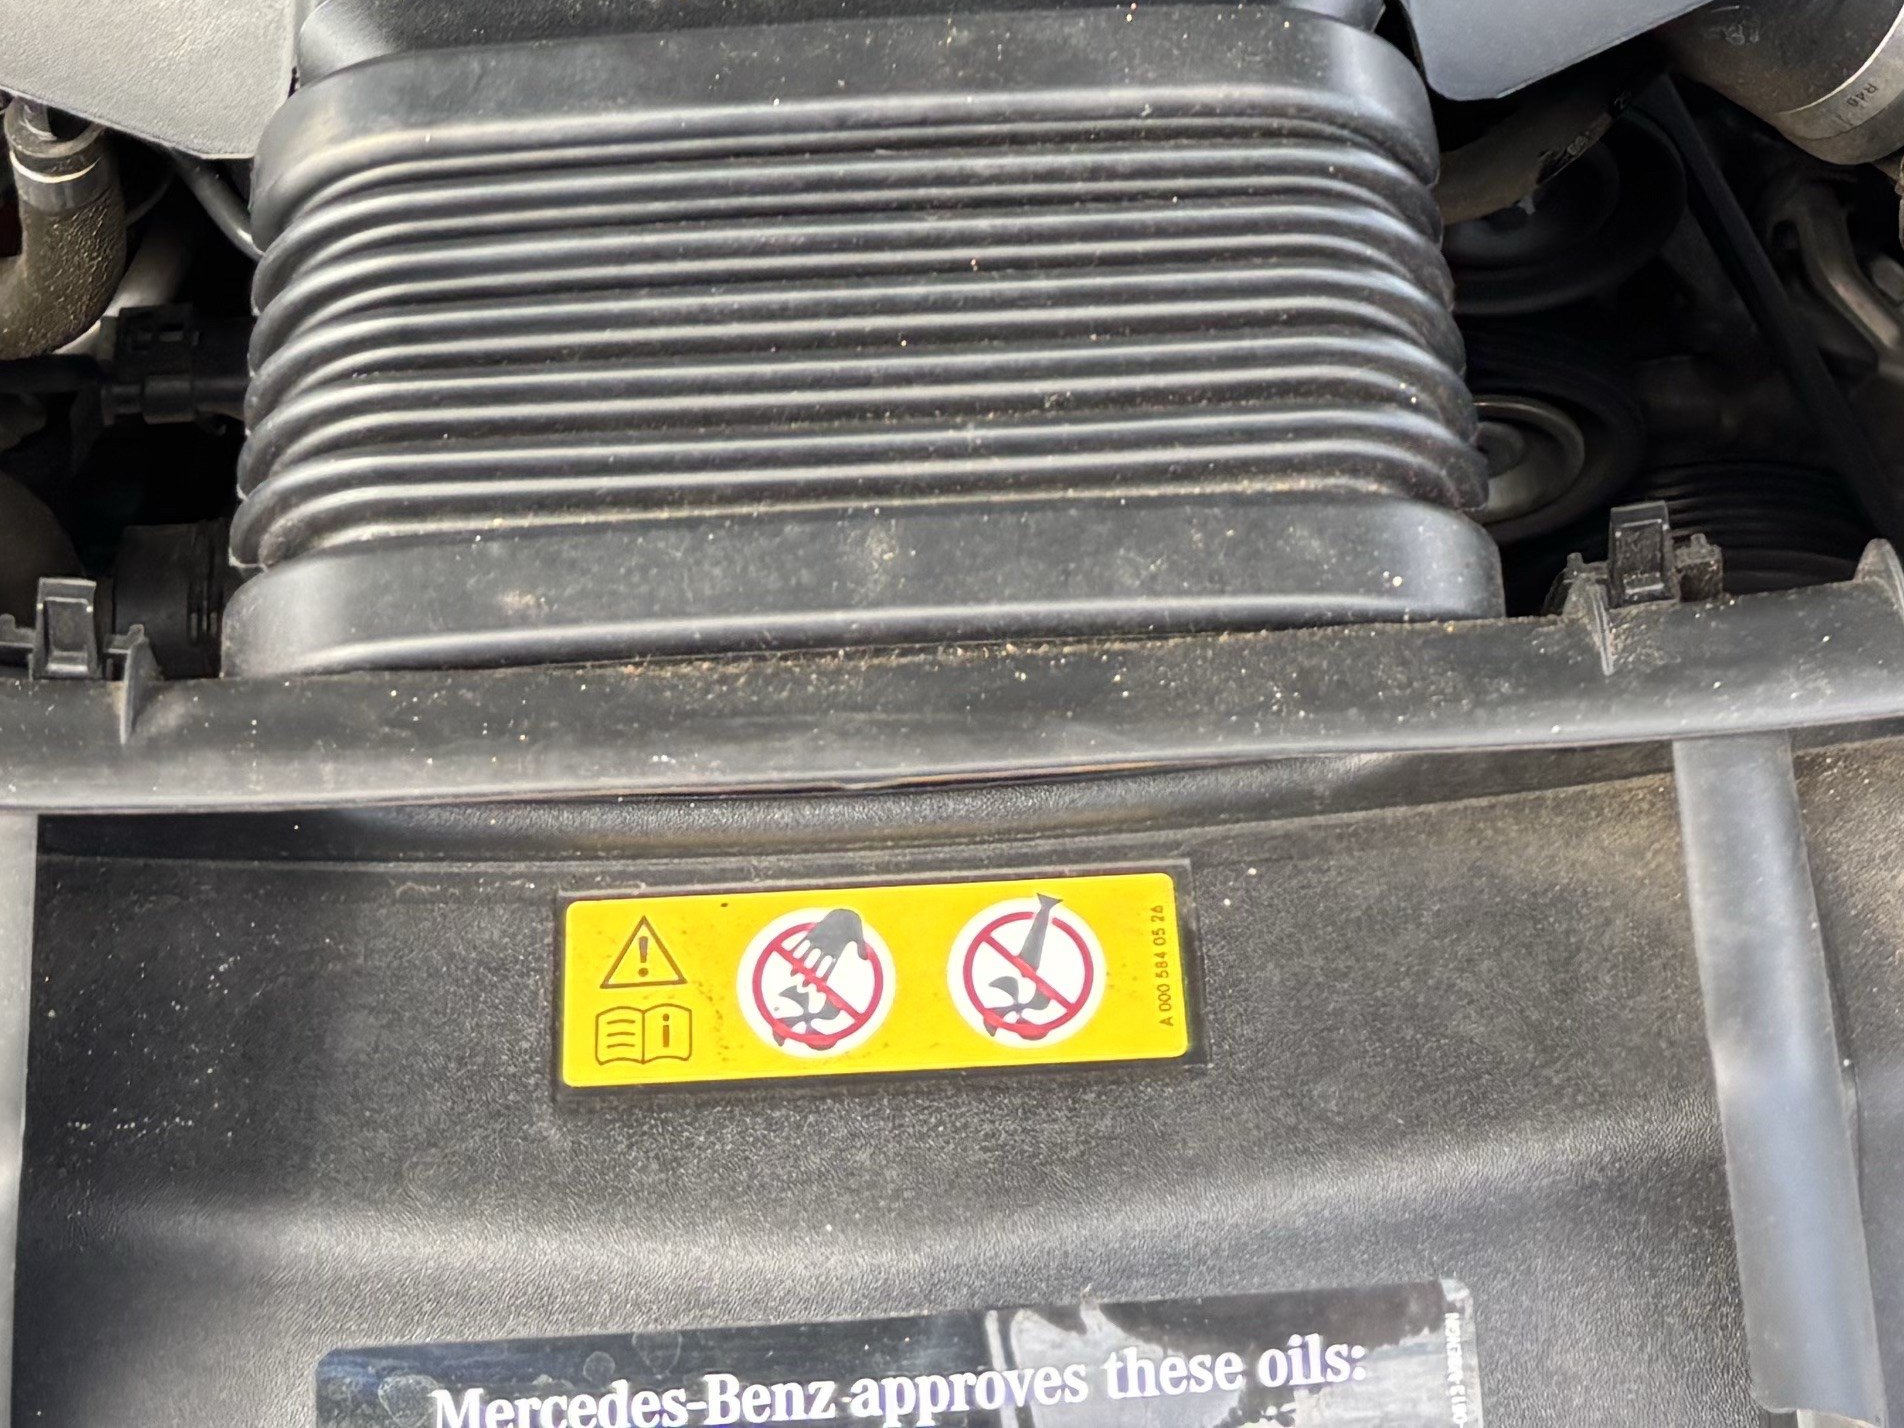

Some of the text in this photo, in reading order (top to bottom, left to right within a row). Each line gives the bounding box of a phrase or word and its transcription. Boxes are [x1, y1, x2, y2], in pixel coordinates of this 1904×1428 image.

[1151, 927, 1167, 947] 05
[1153, 950, 1170, 979] 584
[1156, 983, 1173, 1013] 000
[1158, 1016, 1174, 1027] A
[428, 1332, 1367, 1428] Mercedes-Benz approves these oils:
